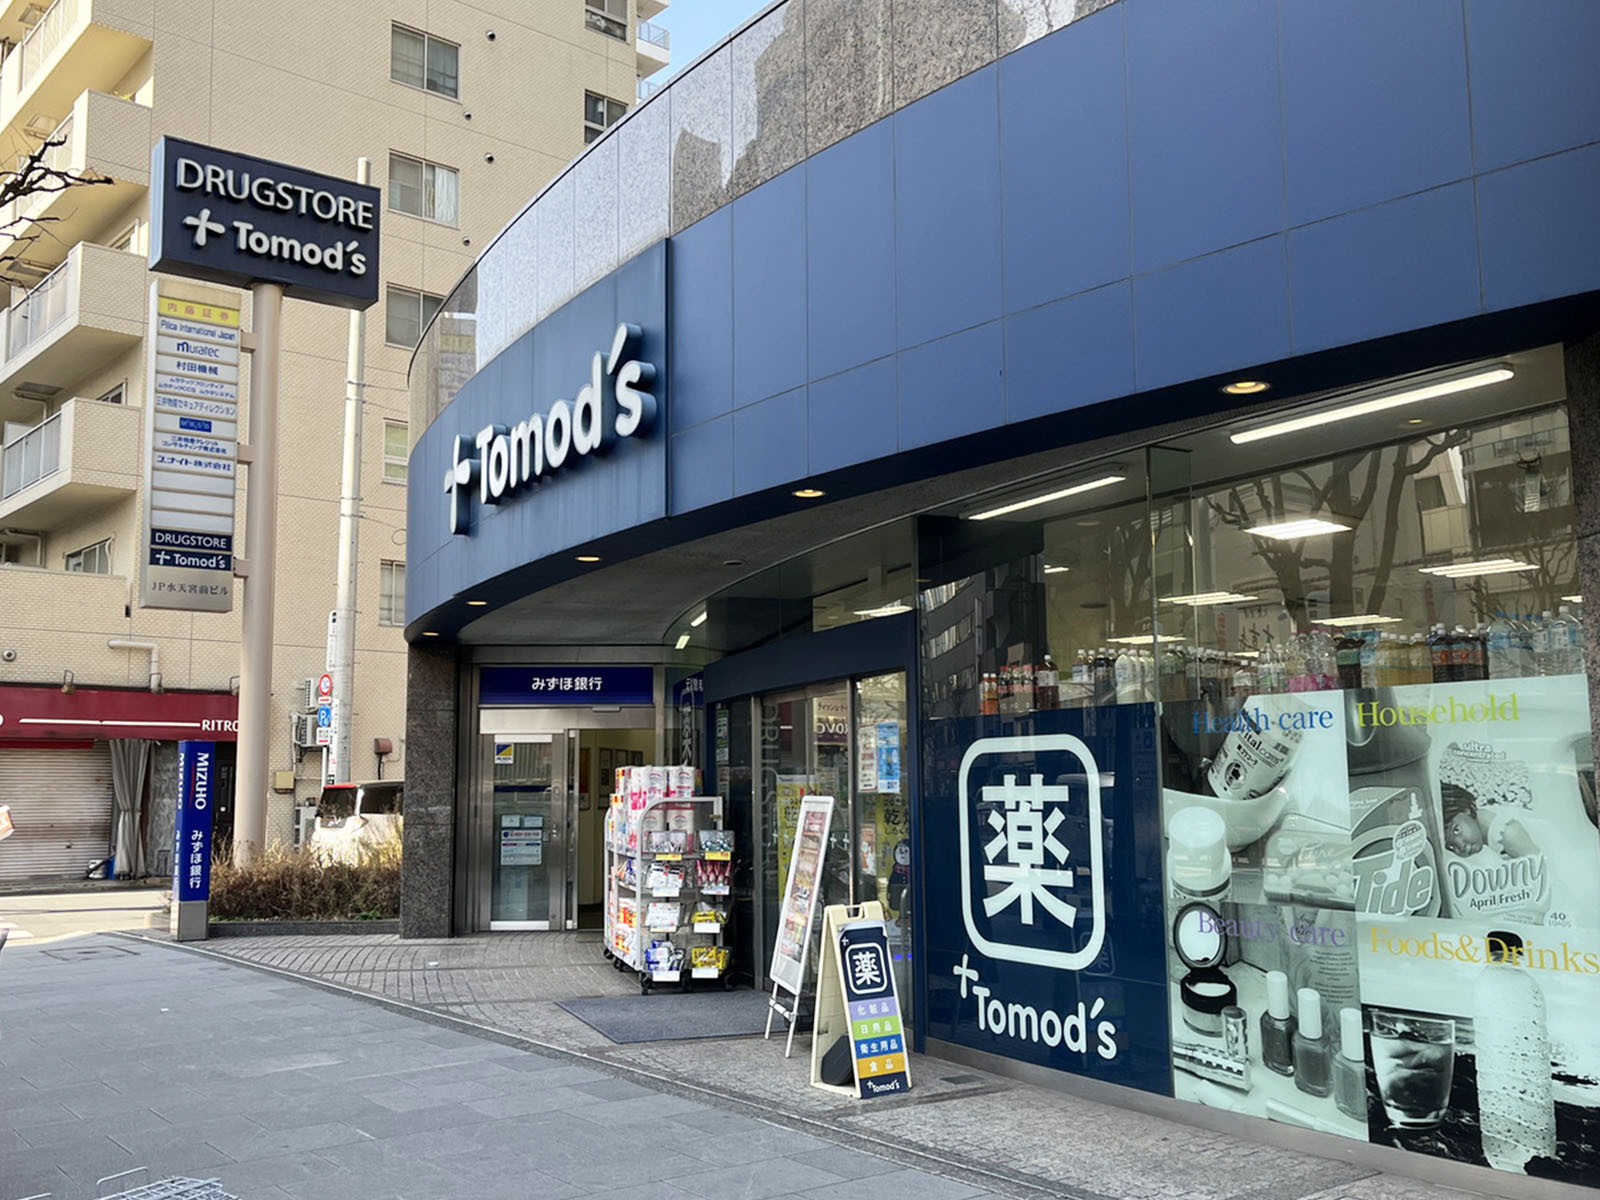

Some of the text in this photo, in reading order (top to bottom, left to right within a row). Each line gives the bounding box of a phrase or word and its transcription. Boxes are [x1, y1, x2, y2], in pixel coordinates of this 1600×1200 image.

[176, 158, 374, 230] DRUGSTORE
[232, 220, 367, 276] Tomod's
[176, 360, 219, 376] 村田機械
[476, 322, 647, 505] Tomod's
[155, 532, 228, 549] DRUGSTORE
[173, 553, 226, 569] Tomod's
[531, 676, 603, 691] みずほ銀行
[1192, 706, 1334, 736] Health care
[1356, 692, 1520, 728] Household
[194, 752, 210, 811] MIZUHO
[189, 829, 204, 889] みずほ銀行
[981, 773, 1078, 929] 薬
[1353, 857, 1434, 916] Tide
[1447, 854, 1545, 903] Downy
[1468, 889, 1531, 910] April Fresh
[1198, 910, 1278, 944] Beauty
[1289, 925, 1346, 948] care
[1550, 912, 1567, 921] 40
[852, 951, 881, 986] 薬
[857, 1002, 890, 1016] 化粧品
[972, 985, 1118, 1061] Tomod's
[860, 1020, 893, 1035] 日用品
[859, 1038, 899, 1054] 衛生用品
[868, 1058, 894, 1073] 食品
[872, 1078, 901, 1093] Tomod's
